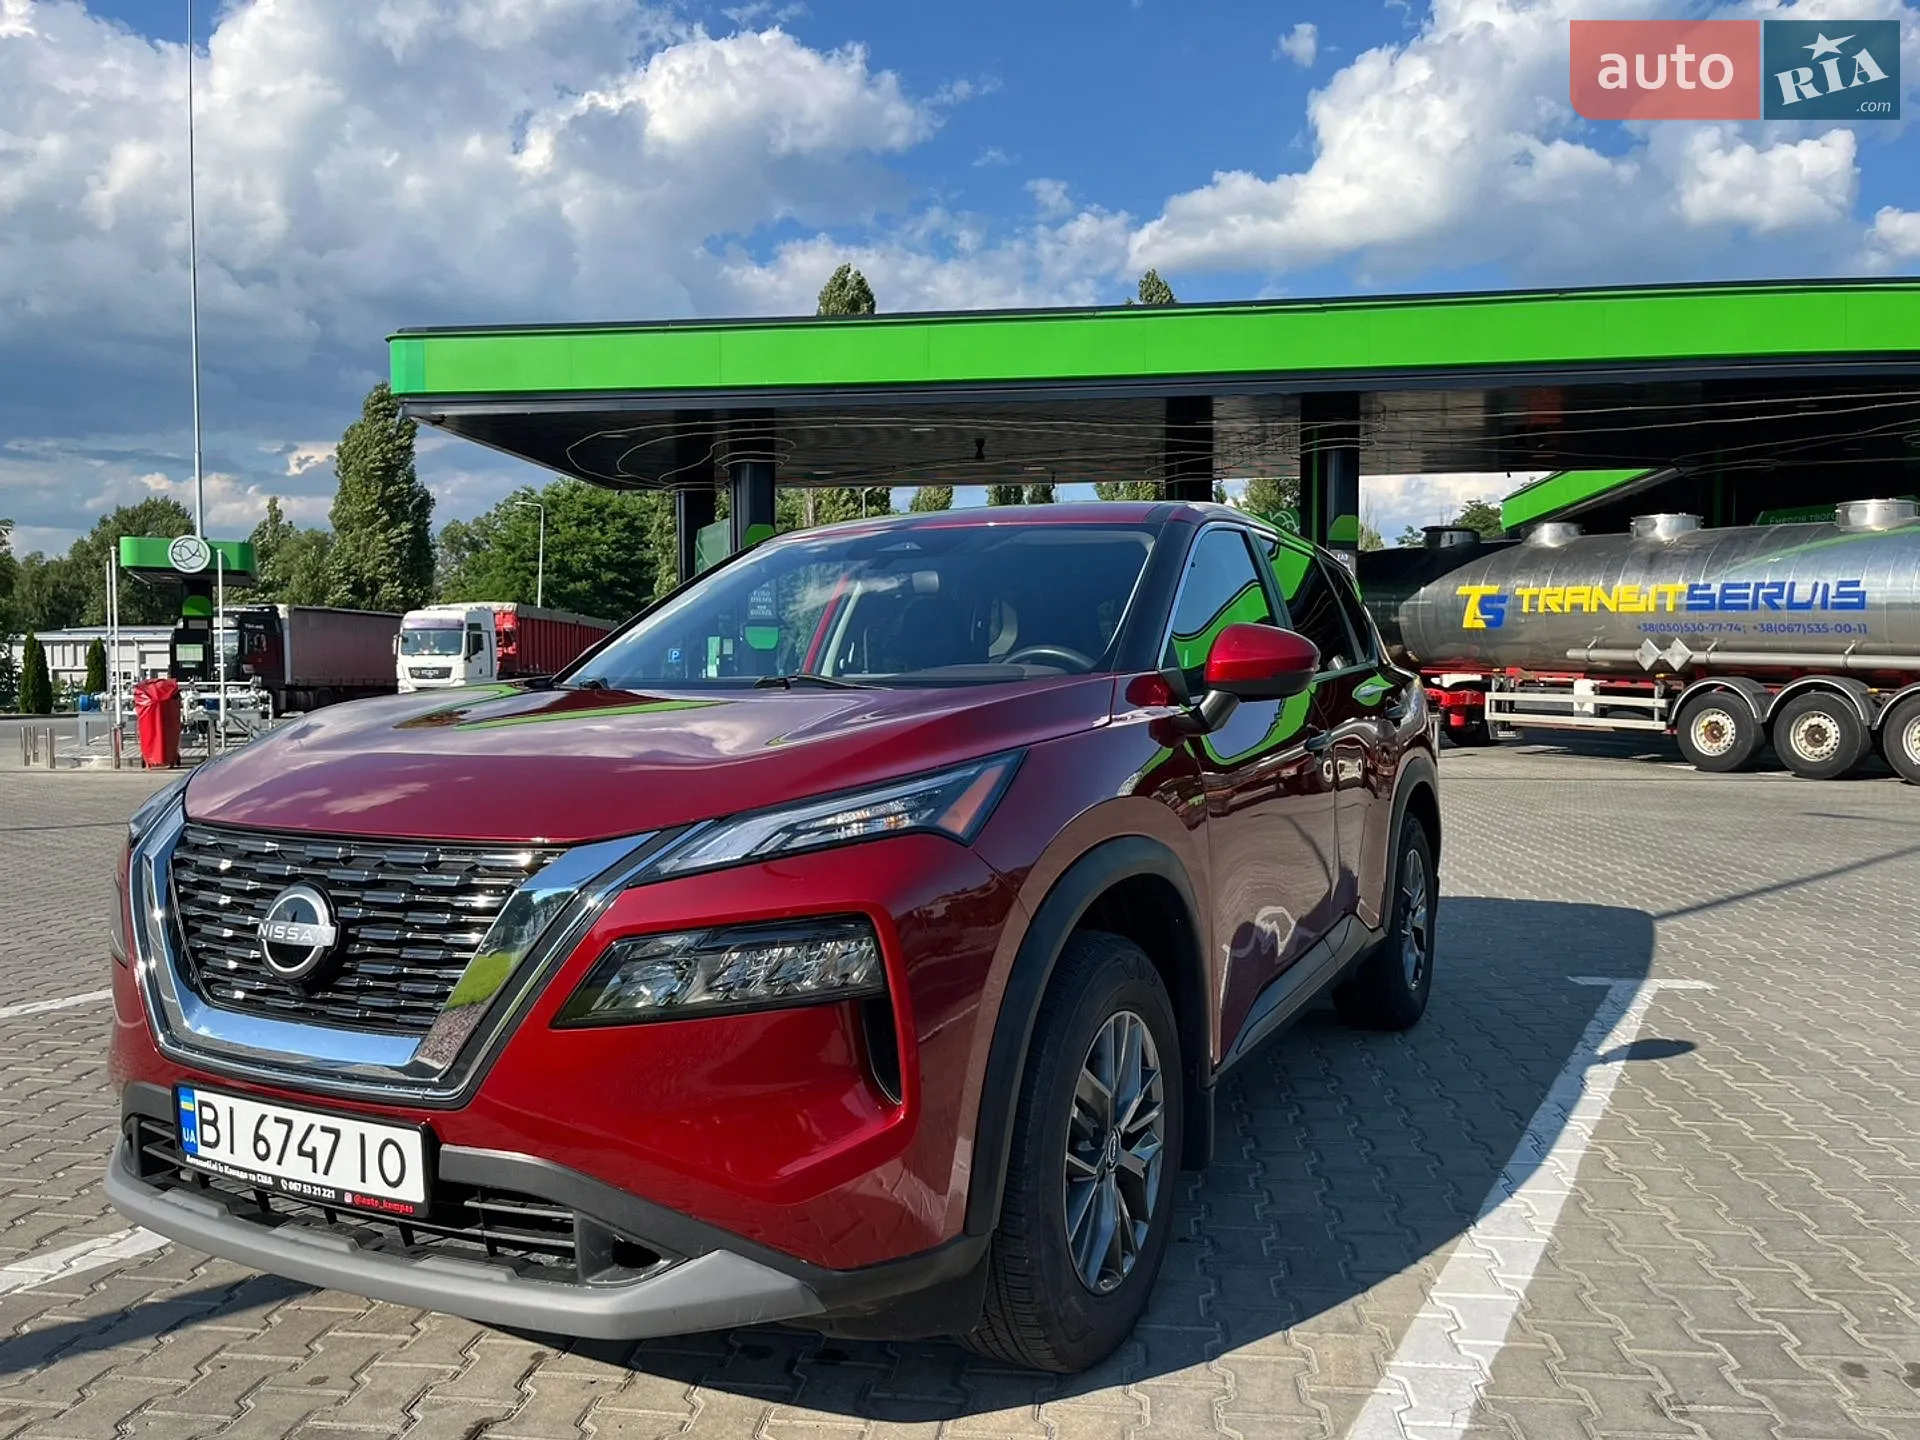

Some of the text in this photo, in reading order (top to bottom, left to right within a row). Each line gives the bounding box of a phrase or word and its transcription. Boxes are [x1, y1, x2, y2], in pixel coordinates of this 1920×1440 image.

[257, 922, 333, 945] NISSAN
[182, 1127, 197, 1145] UA
[198, 1098, 407, 1189] BI 6747 IO
